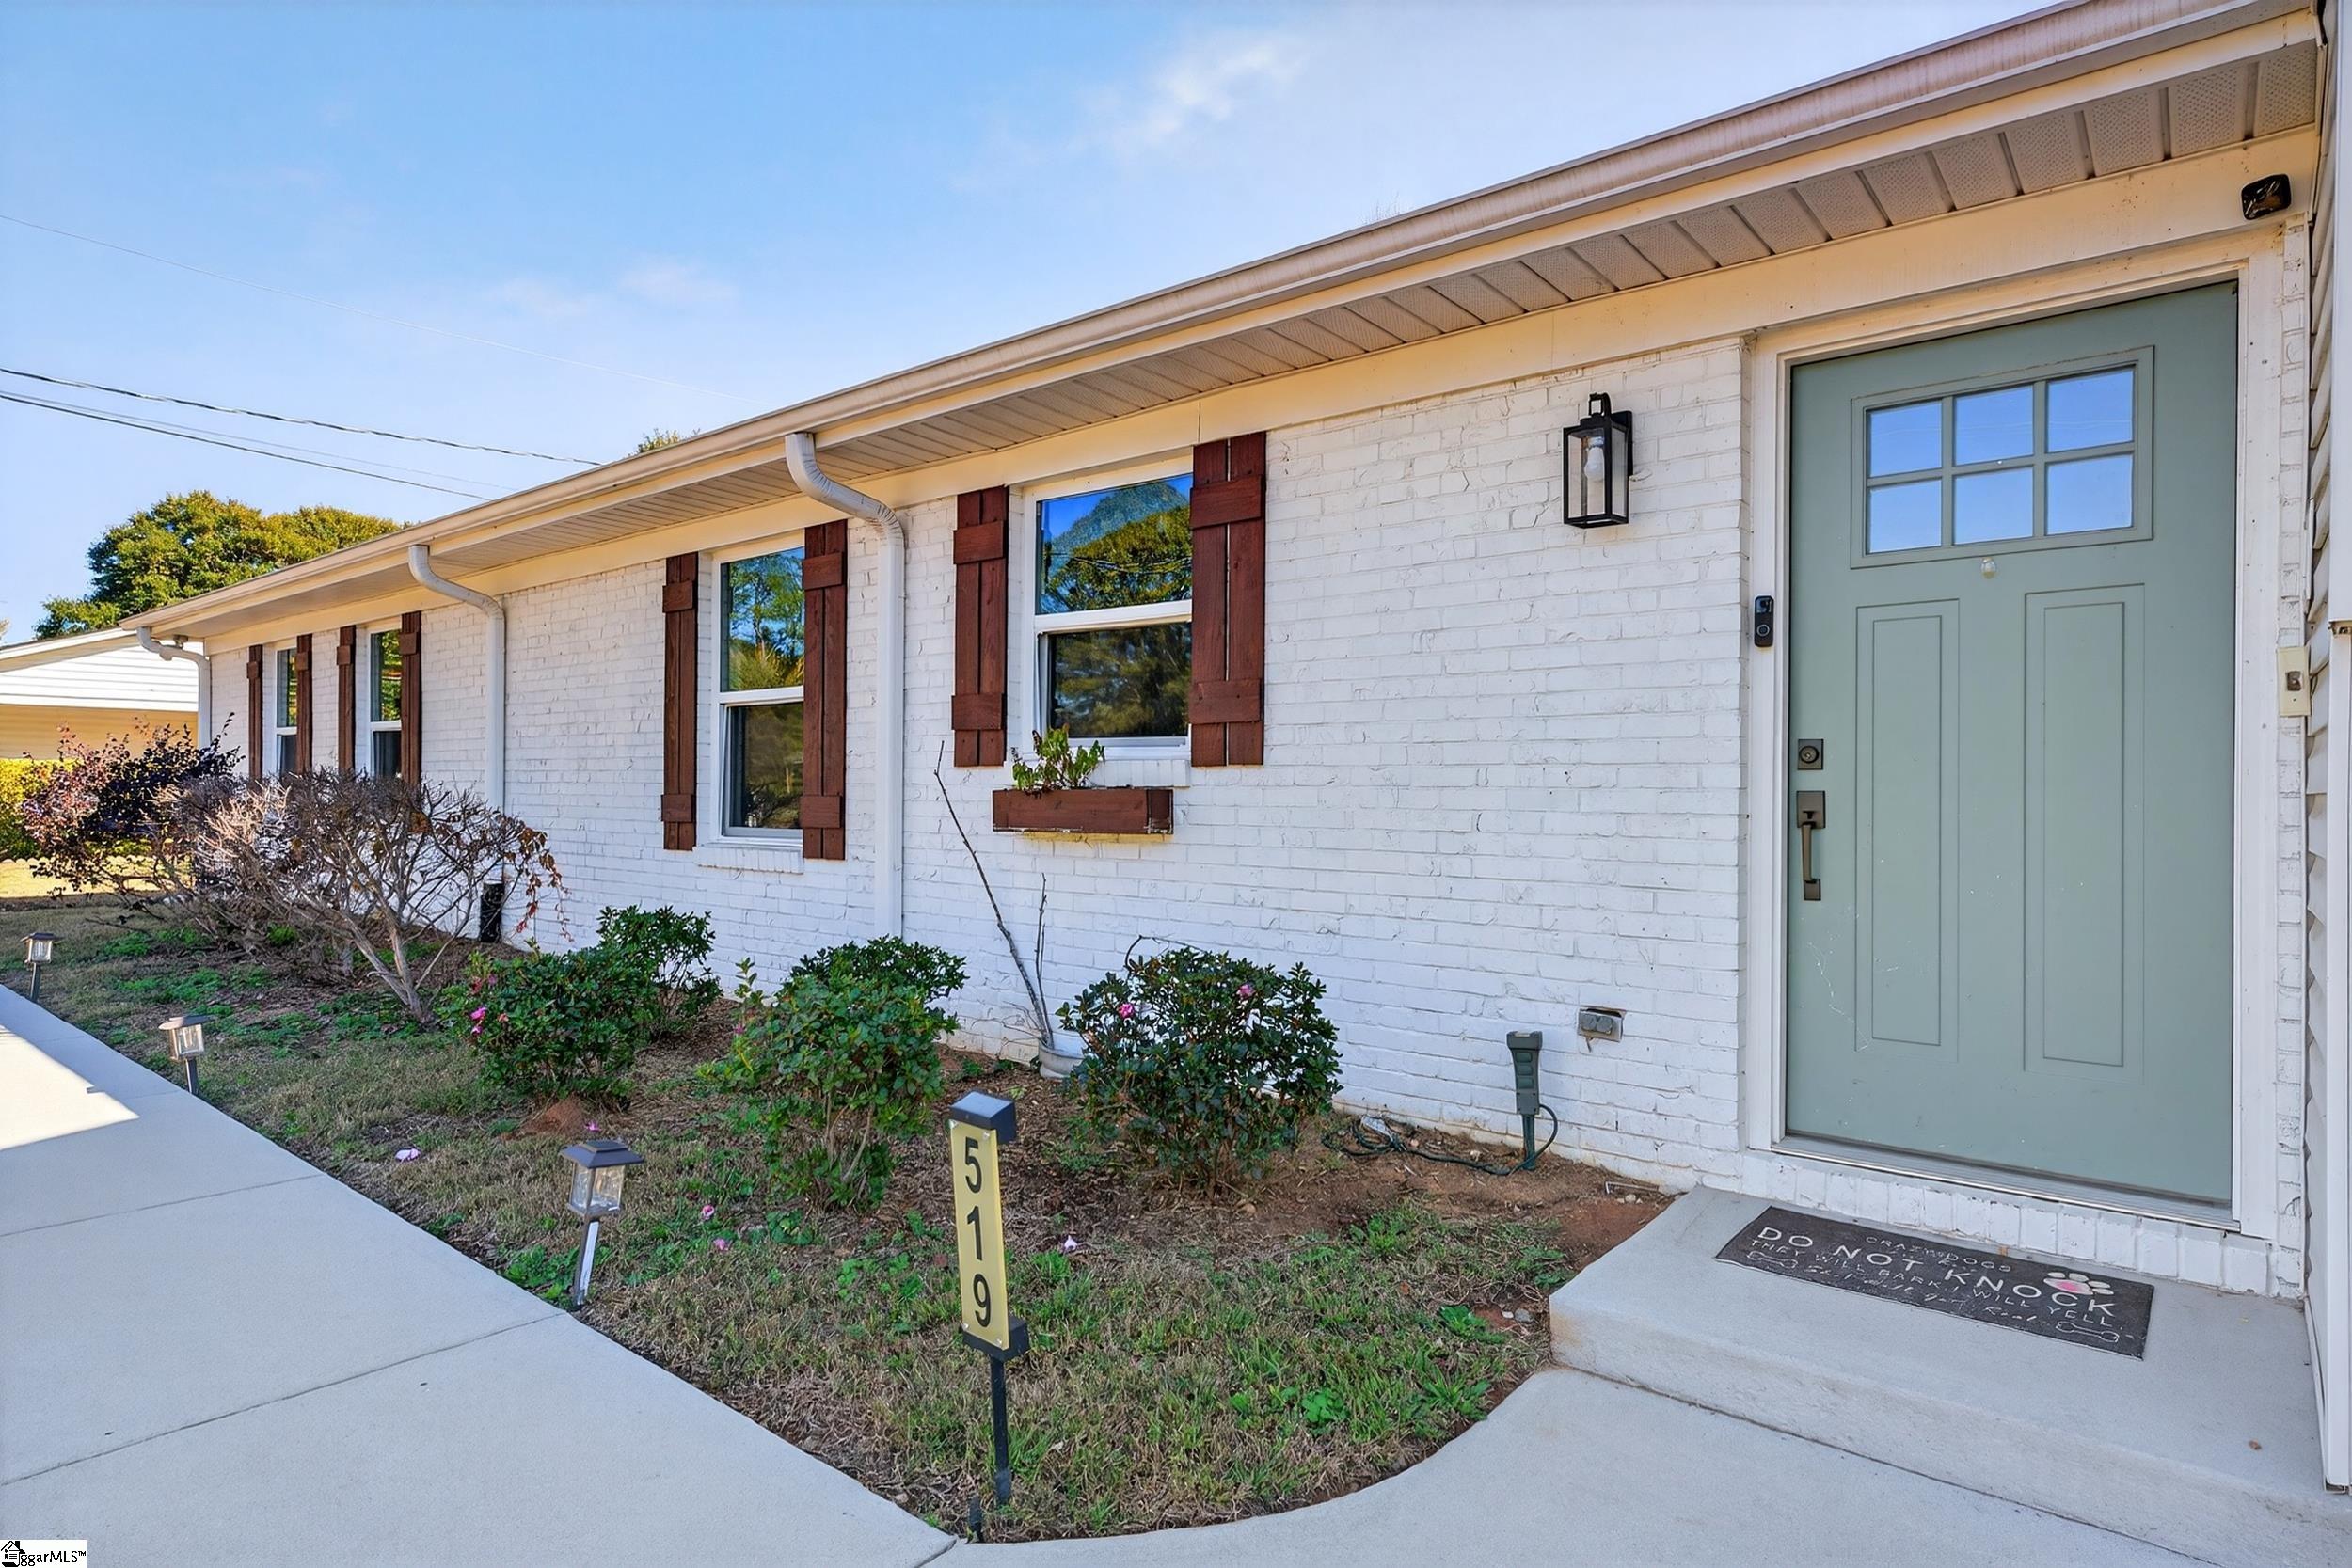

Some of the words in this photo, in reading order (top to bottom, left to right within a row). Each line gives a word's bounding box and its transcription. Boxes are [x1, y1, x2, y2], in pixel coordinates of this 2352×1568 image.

[964, 1135, 992, 1328] 519
[1752, 1239, 1807, 1257] THEY
[1815, 1254, 1865, 1273] WILL
[1972, 1288, 2031, 1308] WILL
[1757, 1227, 1814, 1248] DO
[1832, 1244, 1925, 1271] NOT
[1944, 1269, 2116, 1317] KNOCK
